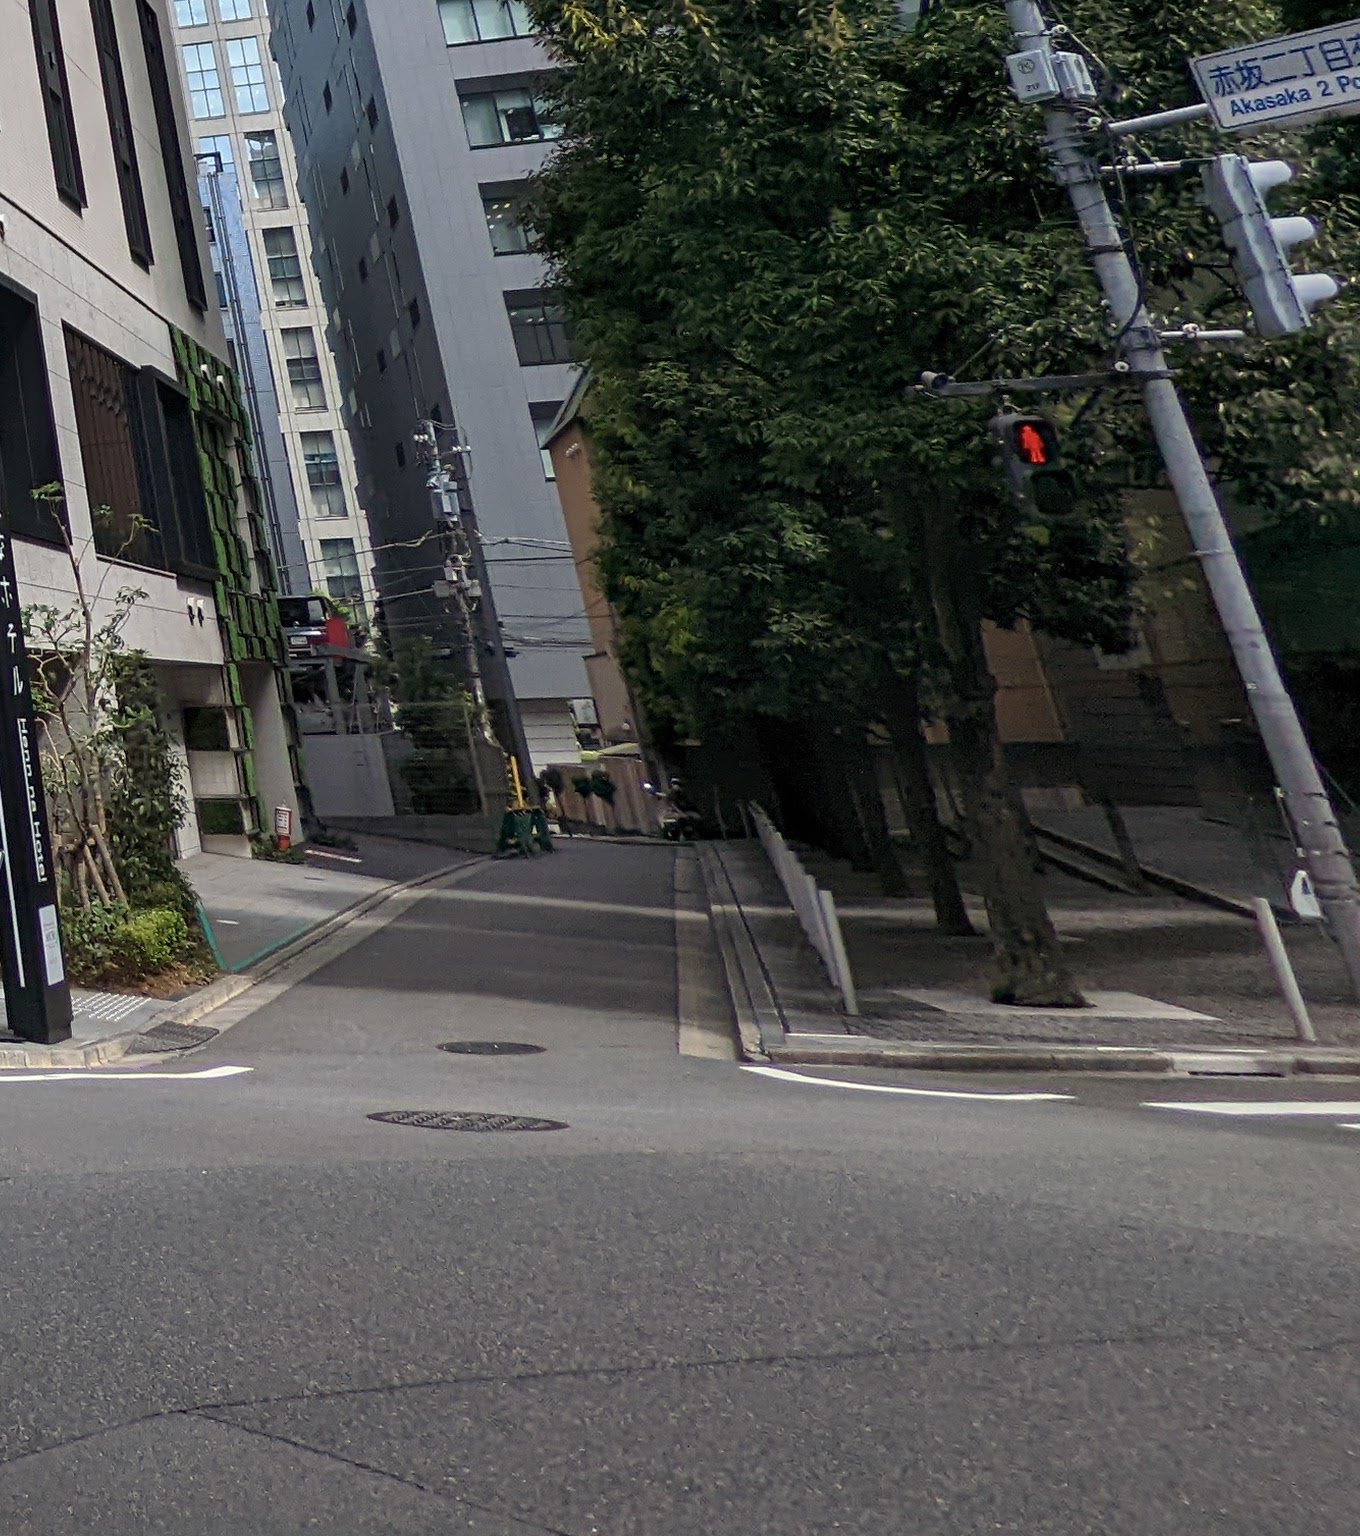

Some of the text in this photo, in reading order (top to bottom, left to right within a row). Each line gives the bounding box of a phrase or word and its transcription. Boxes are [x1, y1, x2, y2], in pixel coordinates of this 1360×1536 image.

[1230, 87, 1312, 116] Akasaka
[1317, 80, 1333, 97] 2
[33, 821, 48, 882] Hotel
